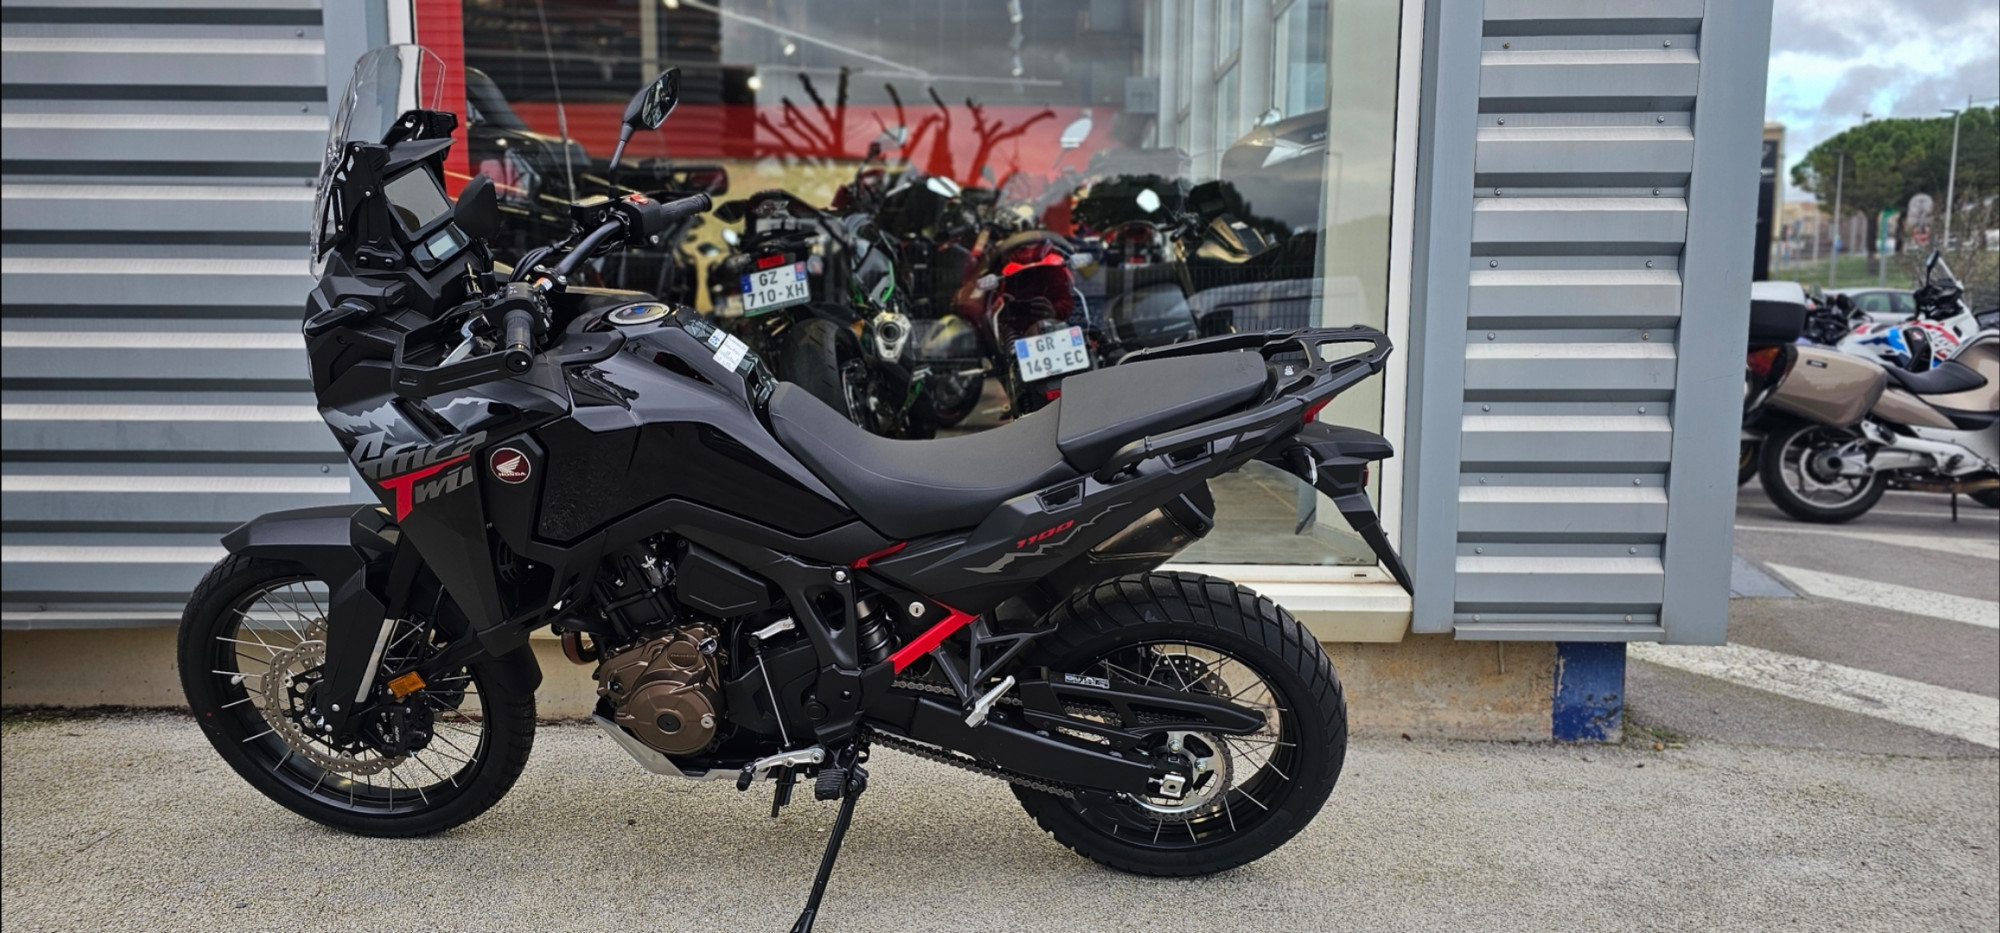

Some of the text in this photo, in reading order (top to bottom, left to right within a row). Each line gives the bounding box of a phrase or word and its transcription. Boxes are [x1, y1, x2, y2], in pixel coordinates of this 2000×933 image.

[747, 282, 805, 307] 710-XH
[1026, 349, 1084, 375] 149-EC
[350, 430, 488, 480] Africa
[1016, 519, 1075, 549] 1100
